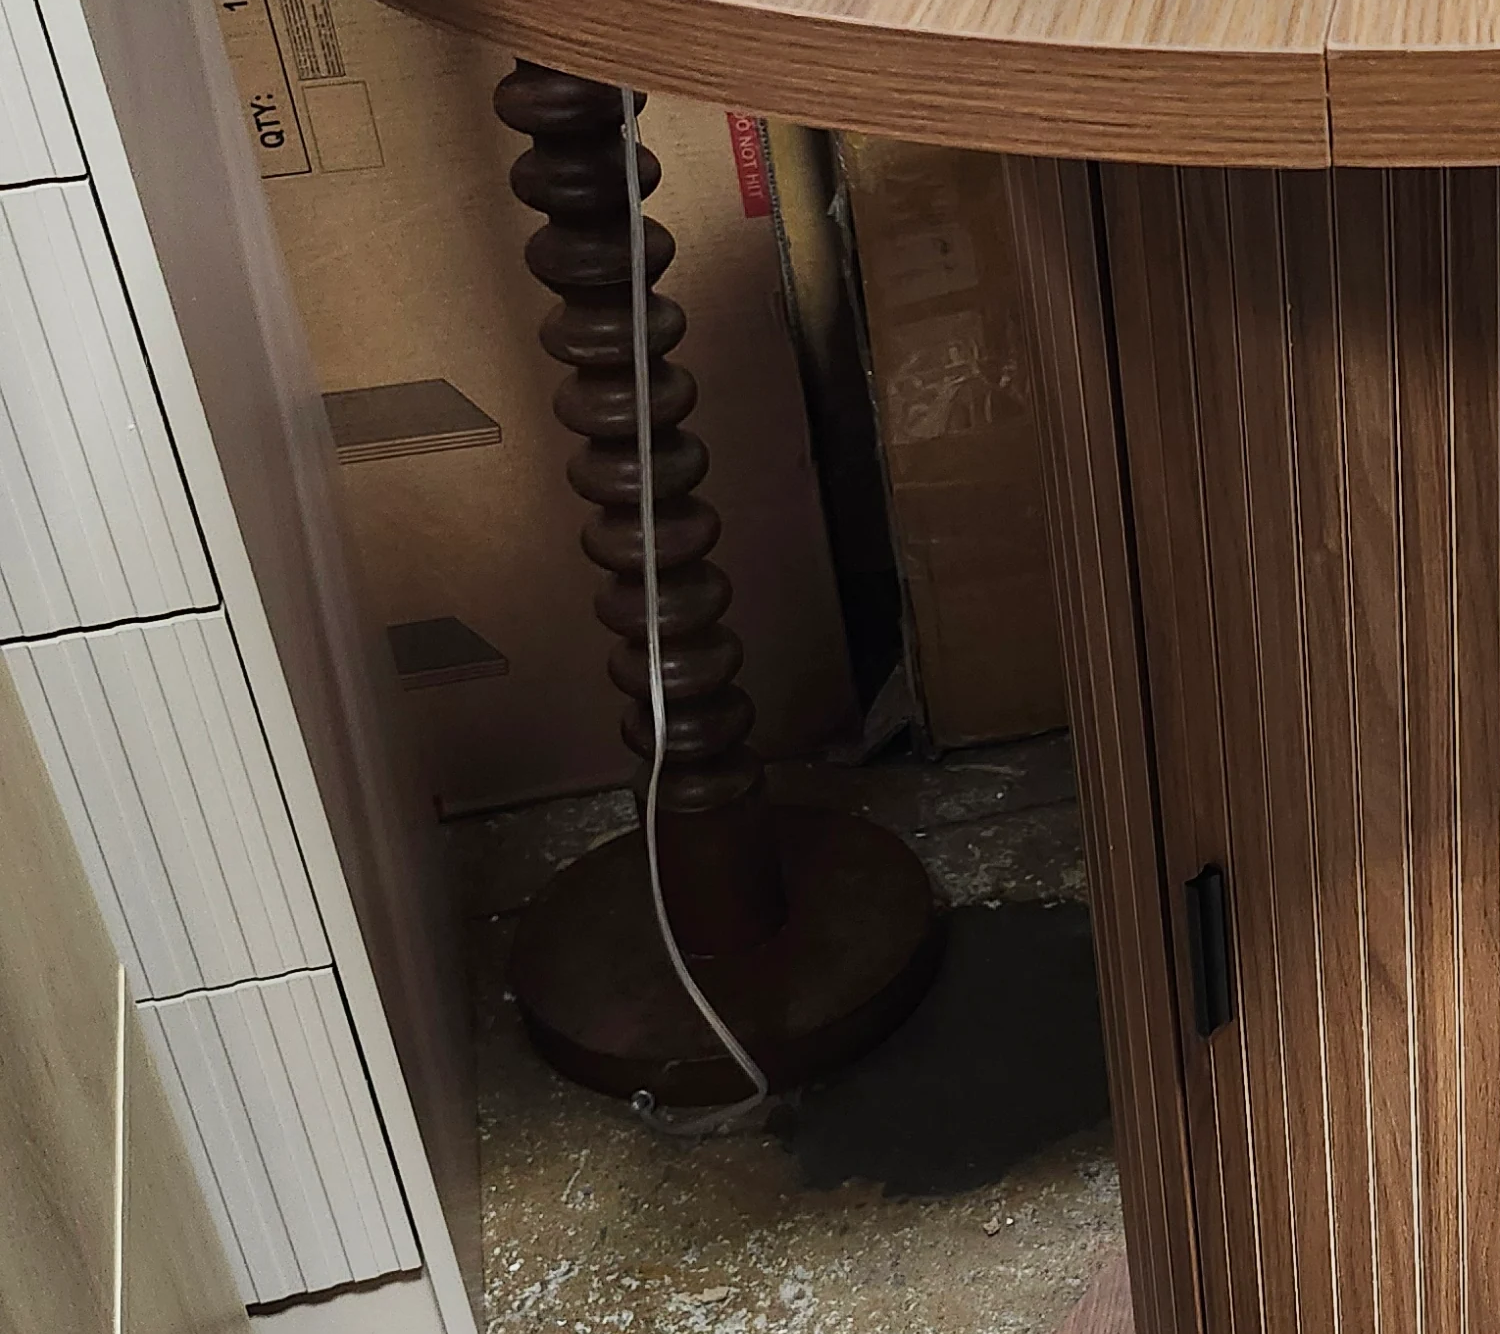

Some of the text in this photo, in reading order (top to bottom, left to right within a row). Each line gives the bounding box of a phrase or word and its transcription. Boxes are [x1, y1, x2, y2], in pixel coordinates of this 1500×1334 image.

[250, 93, 285, 149] QTY:
[739, 135, 758, 169] NOT
[745, 173, 764, 198] HIT
